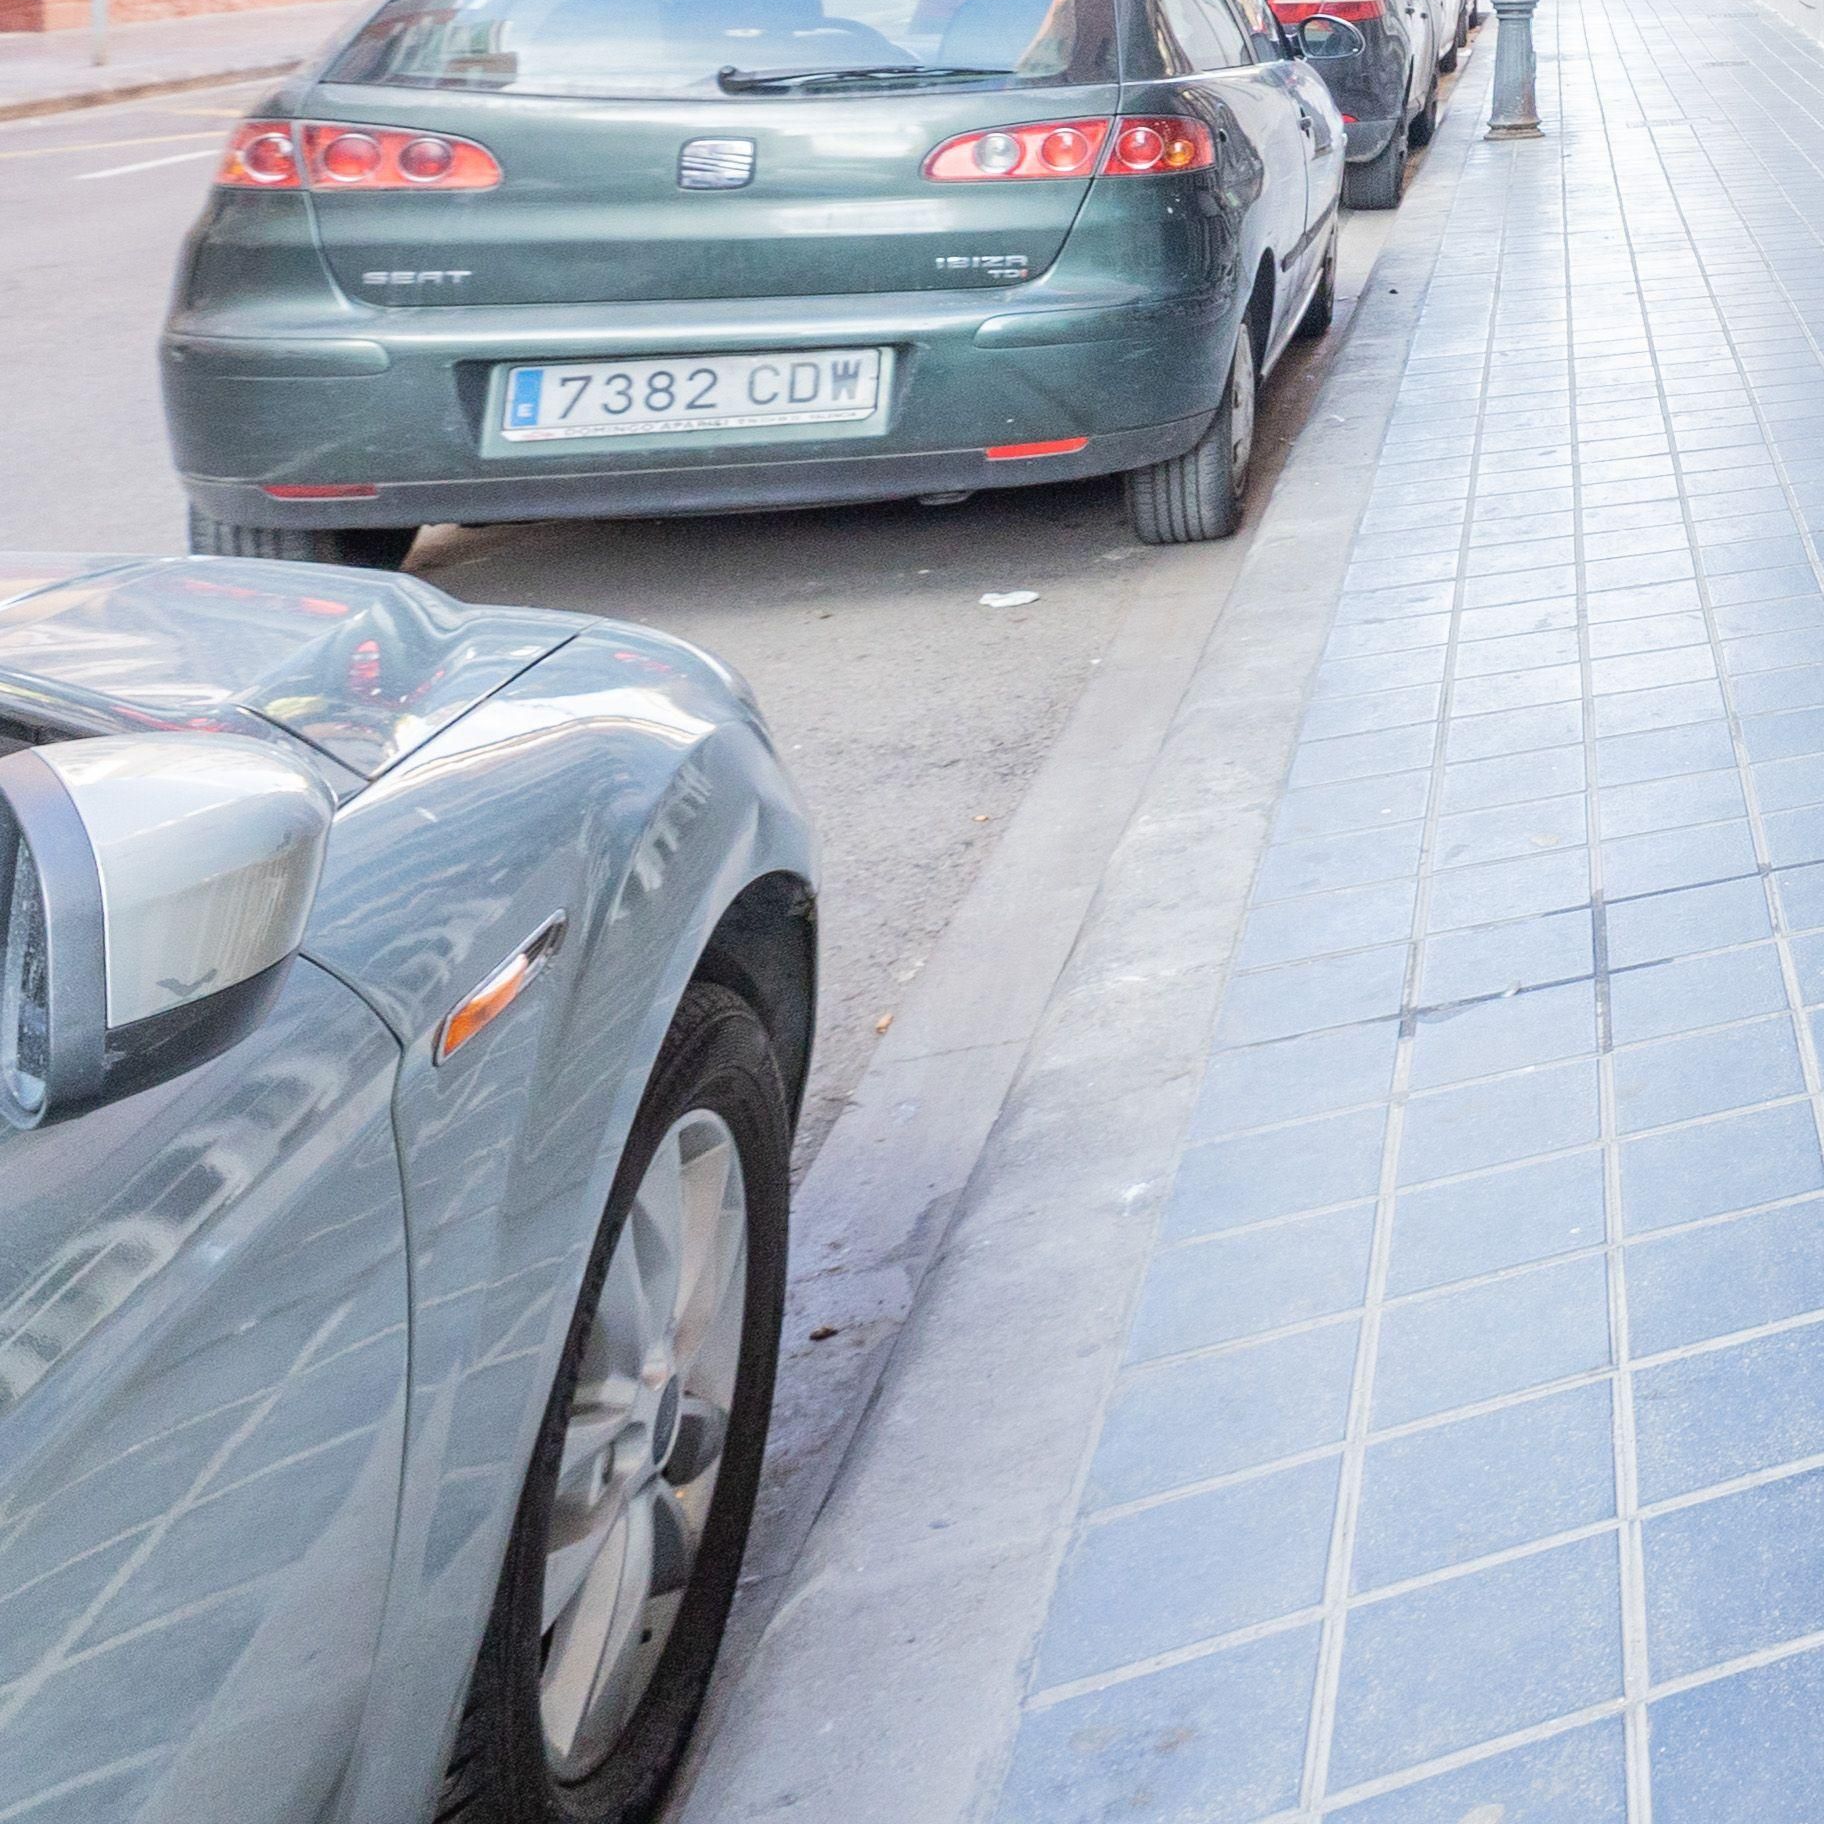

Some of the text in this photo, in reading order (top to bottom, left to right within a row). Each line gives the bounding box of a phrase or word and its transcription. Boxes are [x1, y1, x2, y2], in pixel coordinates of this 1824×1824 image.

[935, 255, 1029, 269] IBIZA
[362, 270, 473, 284] SEAT
[558, 366, 719, 421] 7382
[516, 403, 533, 419] E
[564, 423, 654, 438] DOMINGO
